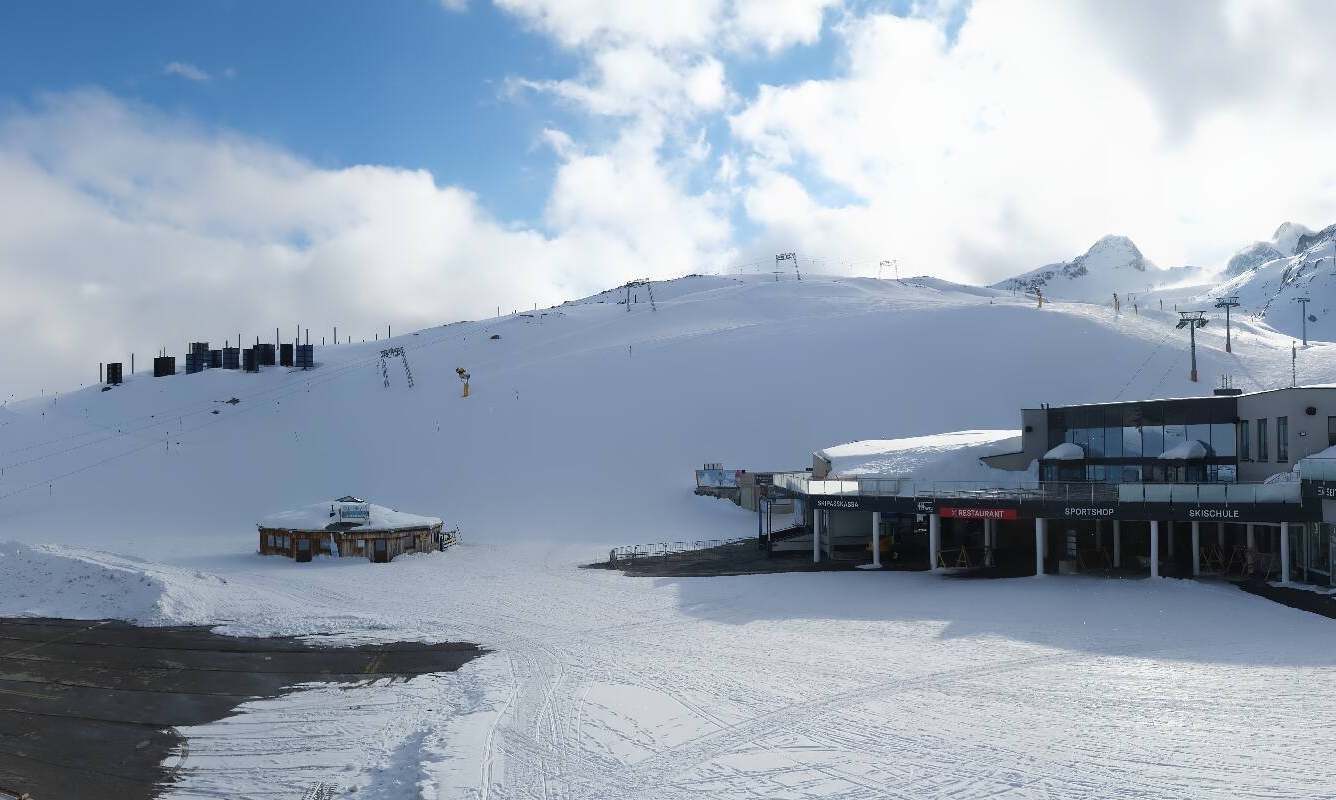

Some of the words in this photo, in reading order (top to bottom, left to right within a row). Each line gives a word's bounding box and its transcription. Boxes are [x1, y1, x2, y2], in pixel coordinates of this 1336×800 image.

[958, 509, 1004, 518] RESTAURANT
[1064, 507, 1114, 516] SPORTSHOP
[1189, 509, 1240, 518] SKISCHULE
